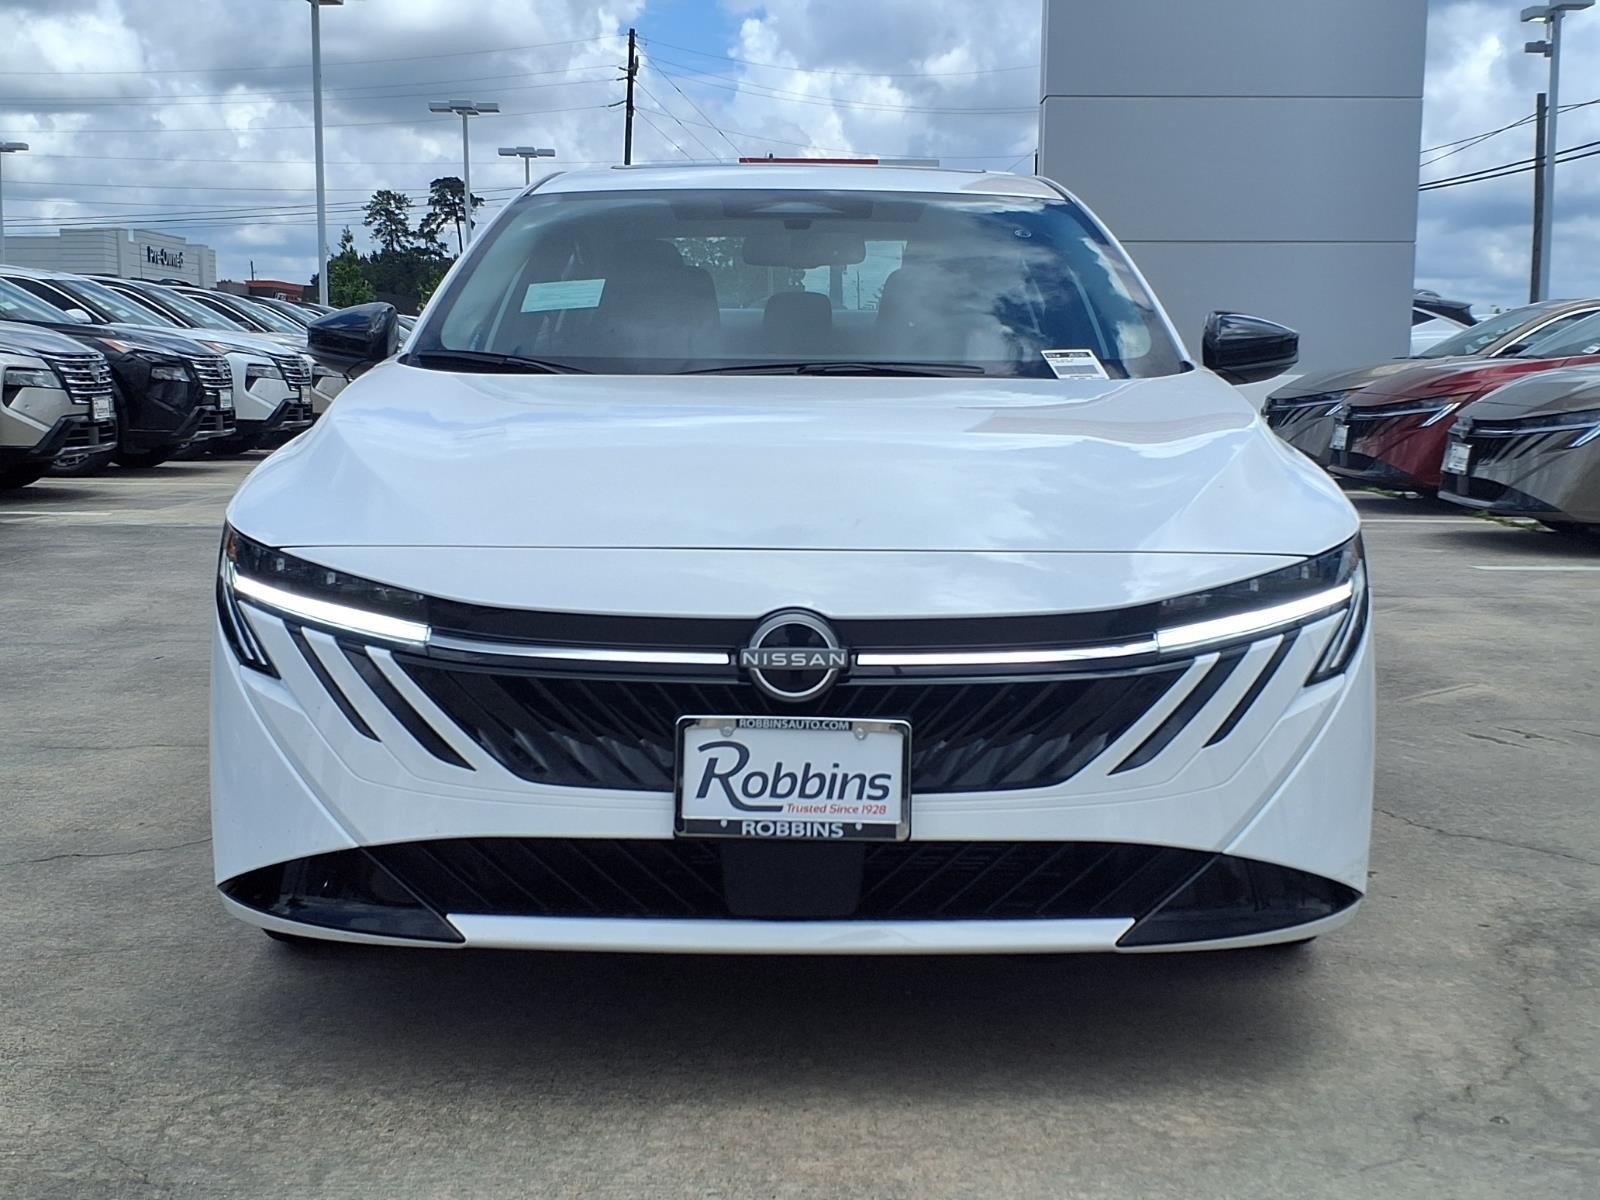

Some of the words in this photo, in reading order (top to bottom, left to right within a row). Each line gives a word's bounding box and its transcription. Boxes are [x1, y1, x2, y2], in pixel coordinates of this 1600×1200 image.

[743, 653, 846, 666] NISSAN
[739, 718, 849, 730] ROBBINSAUTO.COM
[696, 740, 891, 812] Robbins
[786, 802, 828, 814] Trusted
[829, 803, 859, 814] Since
[861, 804, 887, 815] 1928
[741, 821, 844, 838] ROBBINS
